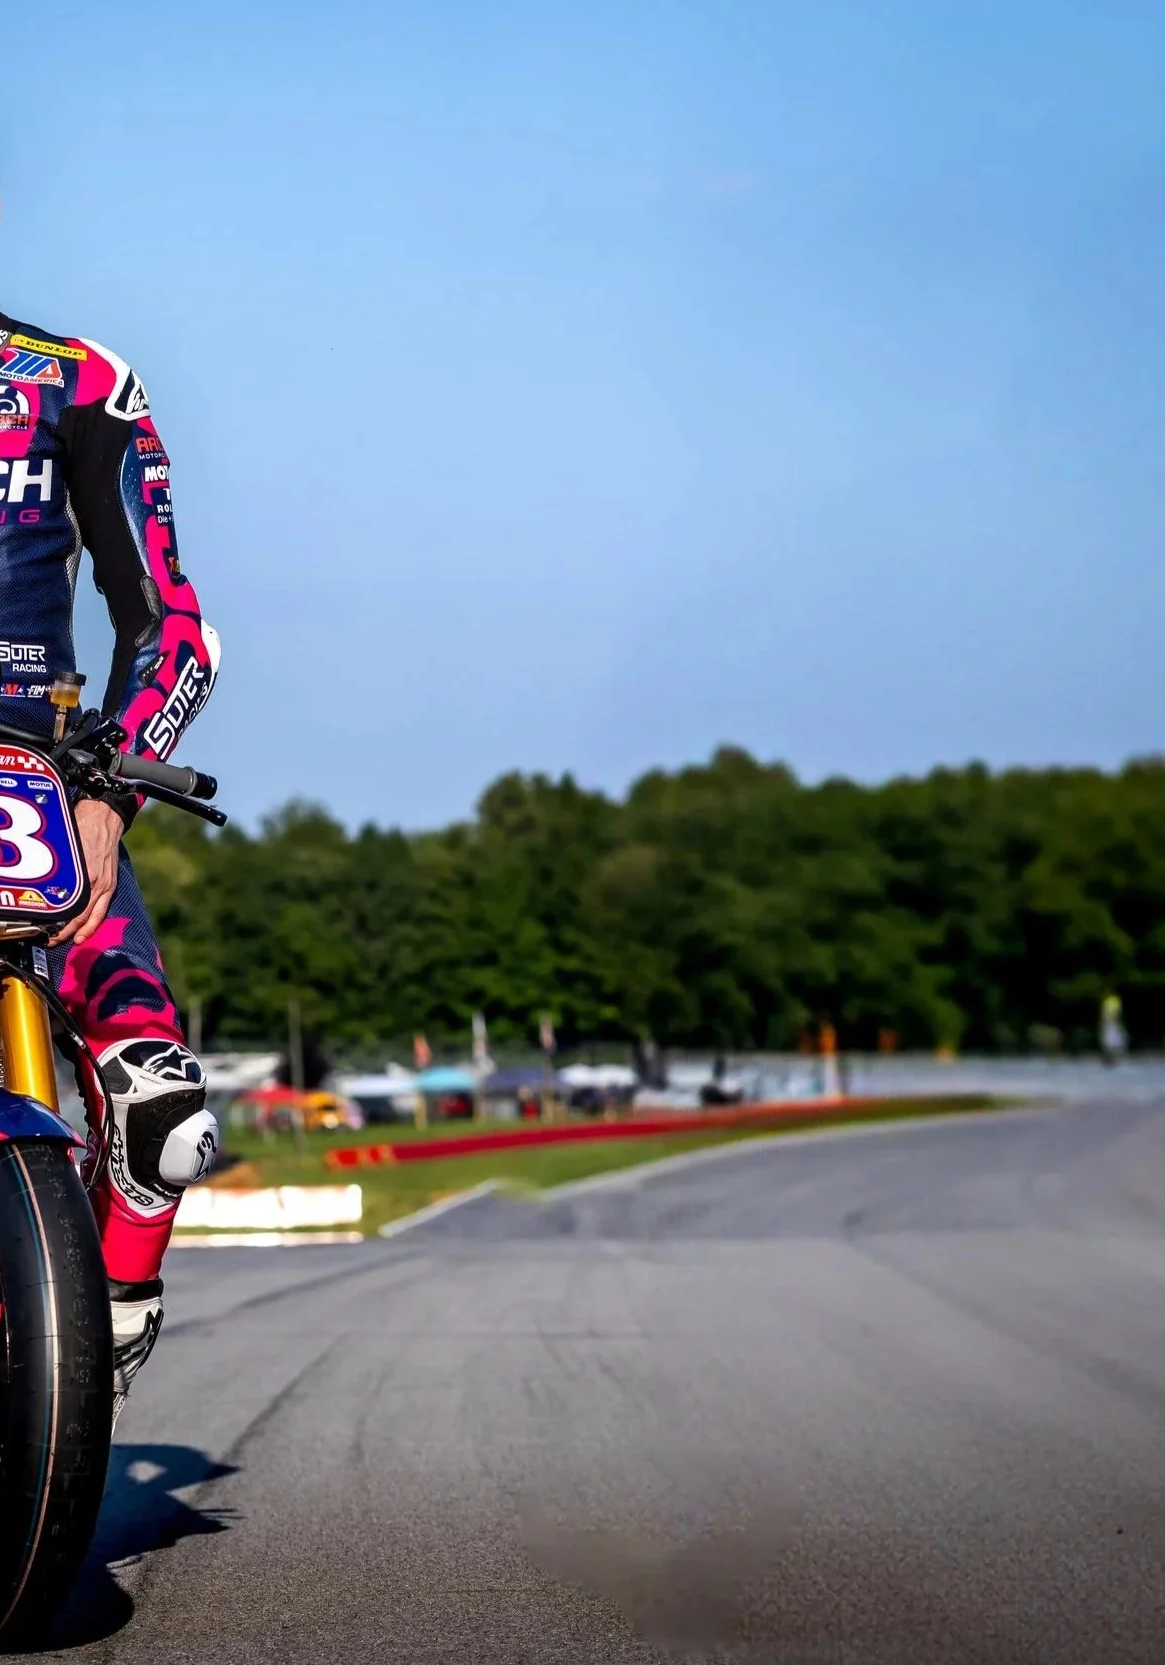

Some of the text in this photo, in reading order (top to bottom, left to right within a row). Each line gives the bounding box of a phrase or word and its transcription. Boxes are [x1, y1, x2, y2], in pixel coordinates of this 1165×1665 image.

[26, 340, 82, 357] DUNLOP
[12, 663, 46, 673] RACING
[143, 656, 205, 760] SUTER
